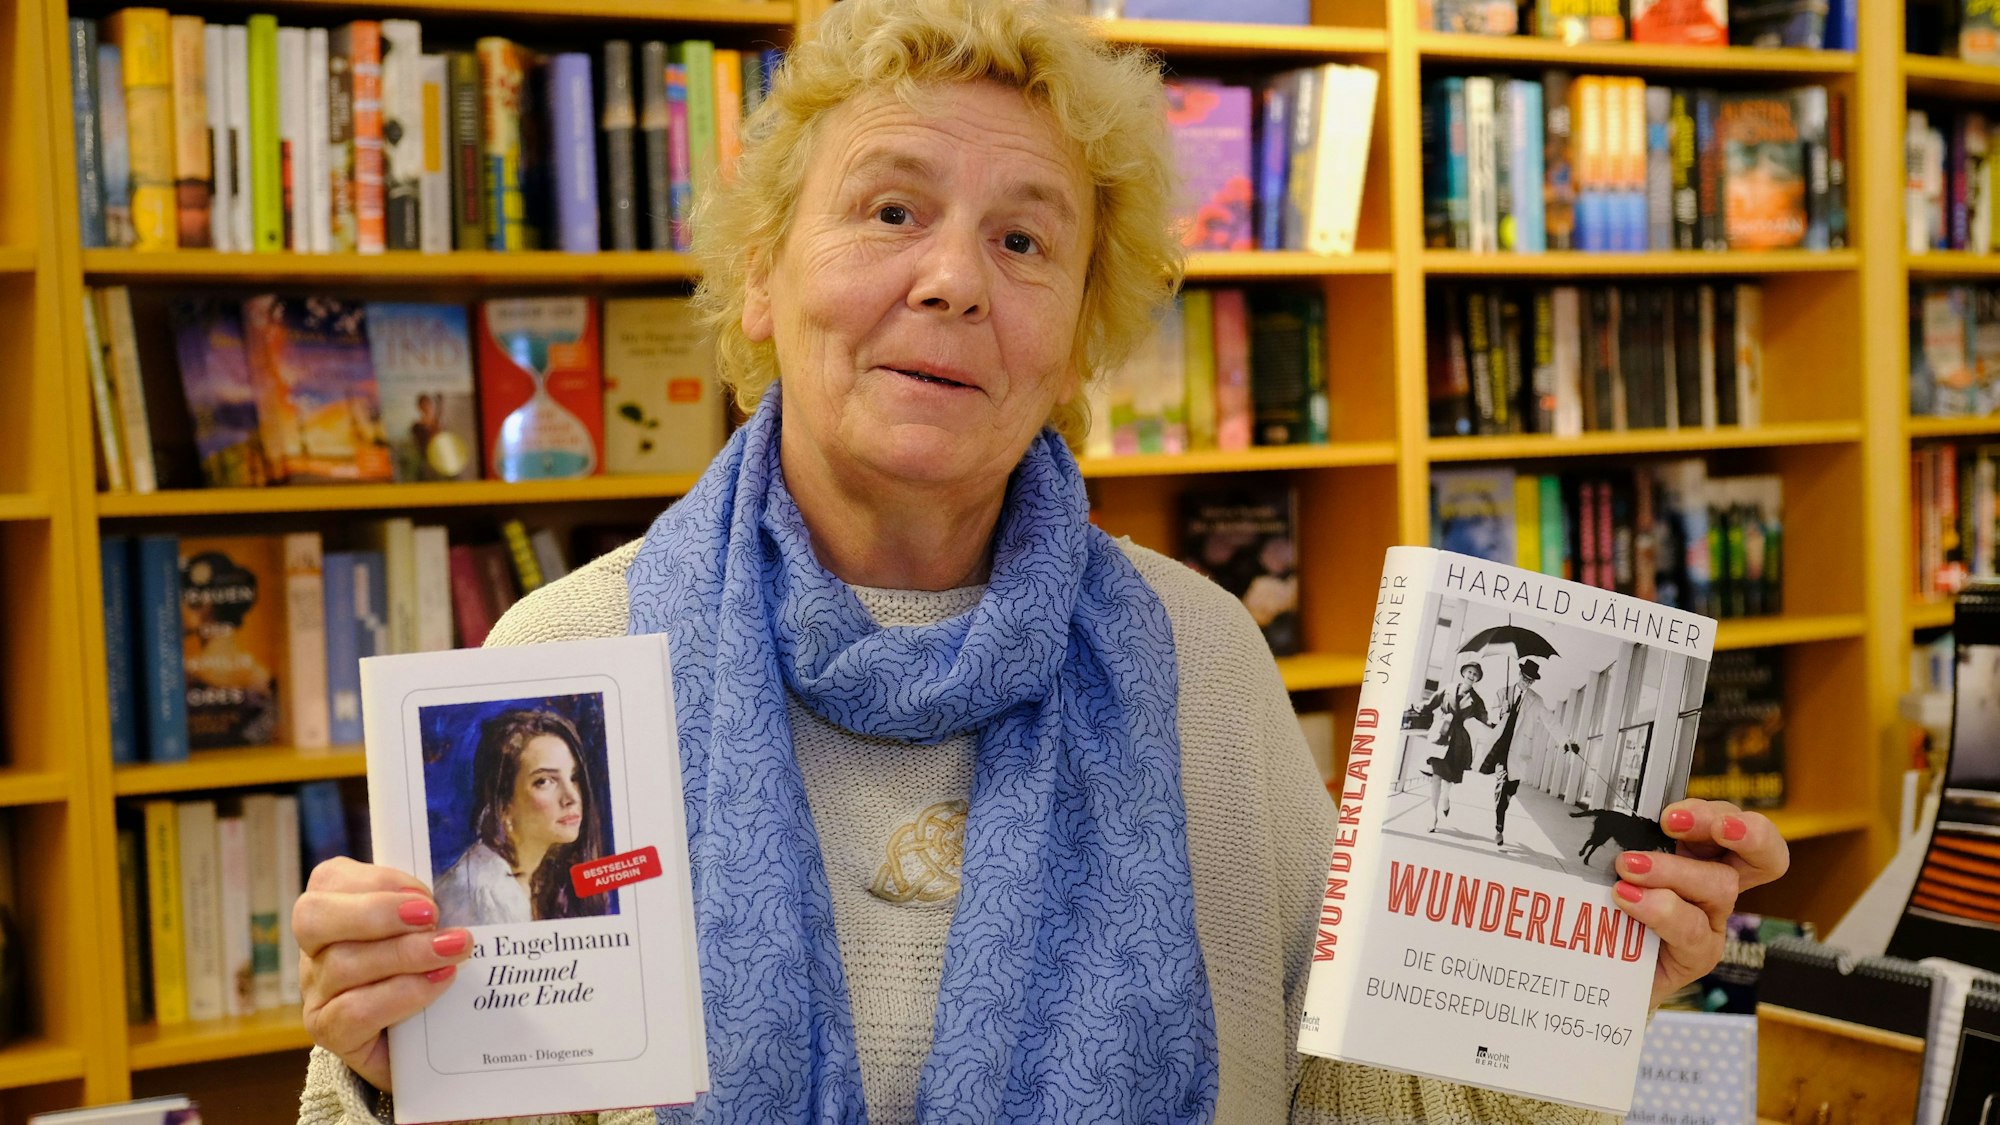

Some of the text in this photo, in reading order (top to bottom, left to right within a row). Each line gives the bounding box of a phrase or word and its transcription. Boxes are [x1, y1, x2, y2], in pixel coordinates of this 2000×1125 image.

[1446, 563, 1701, 650] HARALD JÄHNER
[1377, 575, 1408, 684] JÄHNER
[1312, 708, 1380, 962] WUNDERLAND
[583, 854, 648, 879] BESTSELLER
[595, 867, 642, 887] AUTORIN
[1388, 861, 1646, 963] WUNDERLAND
[493, 931, 632, 961] Engelmann
[486, 959, 579, 986] Himmel
[1403, 948, 1611, 1008] DIE GRÜNDERZEIT DER
[473, 982, 595, 1011] ohne Ende
[1366, 977, 1539, 1030] BUNDESREPUBLIK
[482, 1048, 594, 1065] Roman Diogenes
[1475, 1057, 1509, 1070] BERLIN
[1641, 1067, 1703, 1085] HACKE
